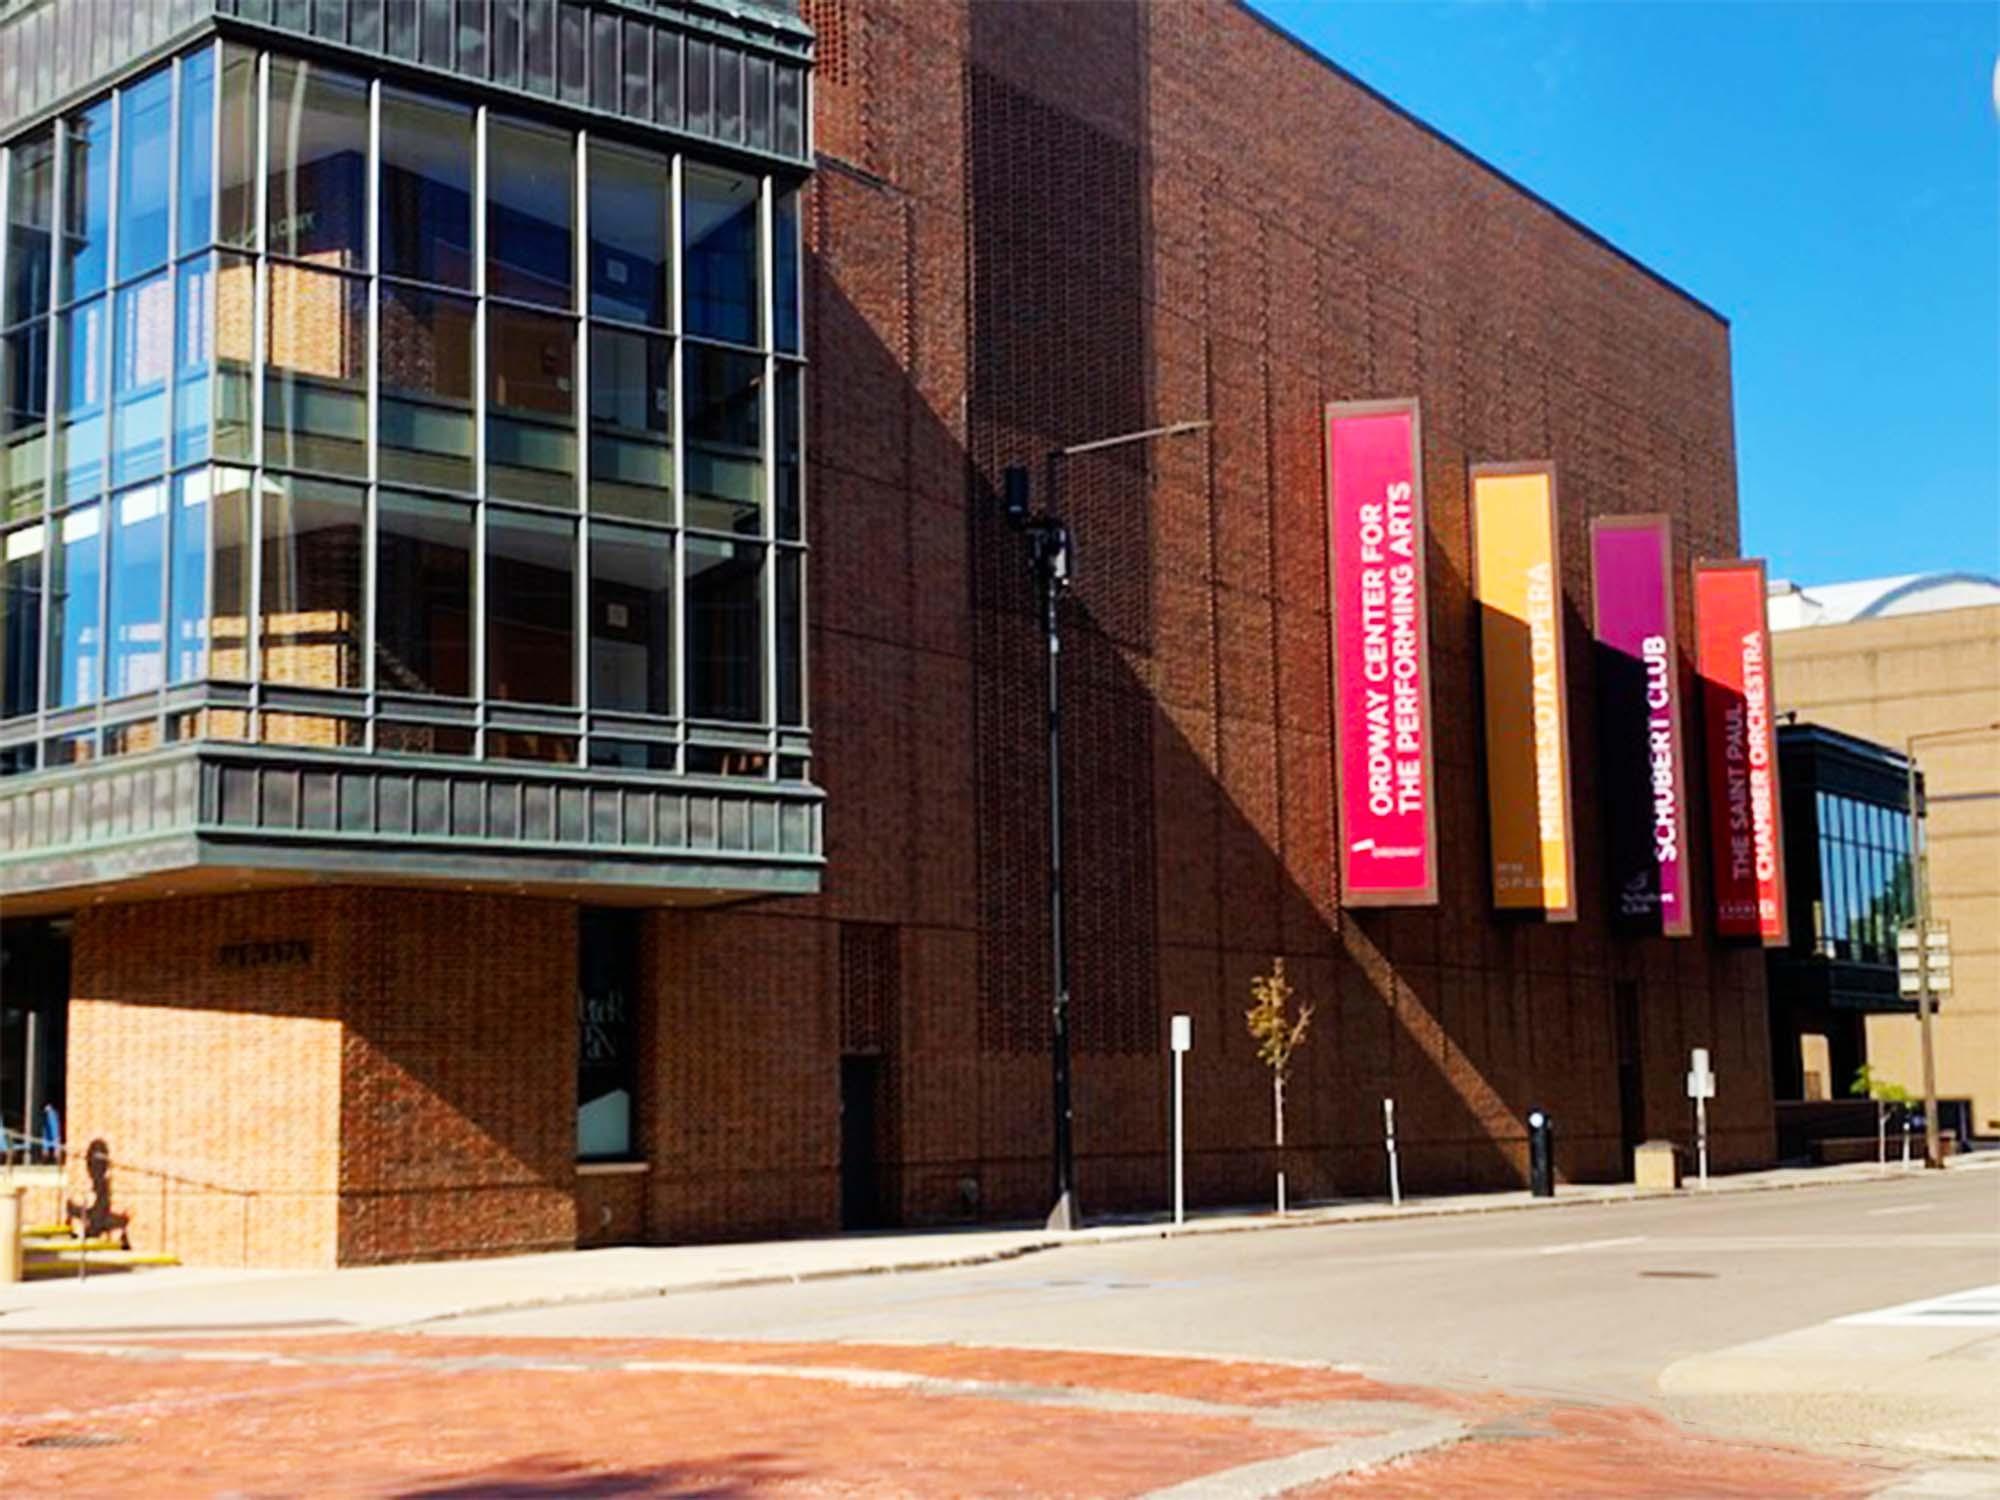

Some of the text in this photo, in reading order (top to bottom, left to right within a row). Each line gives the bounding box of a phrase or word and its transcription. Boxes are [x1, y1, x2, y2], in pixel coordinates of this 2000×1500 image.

[1387, 481, 1413, 557] ARTS
[1360, 503, 1393, 816] ORDWAY CENTER FOR
[1389, 564, 1420, 752] PERFORMING
[1528, 562, 1563, 841] MINNESOTA OPERA
[1642, 635, 1677, 863] SCHUBERT CLUB
[1742, 631, 1774, 882] CHAMBER ORCHESTRA
[1395, 758, 1422, 816] THE
[1725, 702, 1750, 880] THE SAINT PAUL
